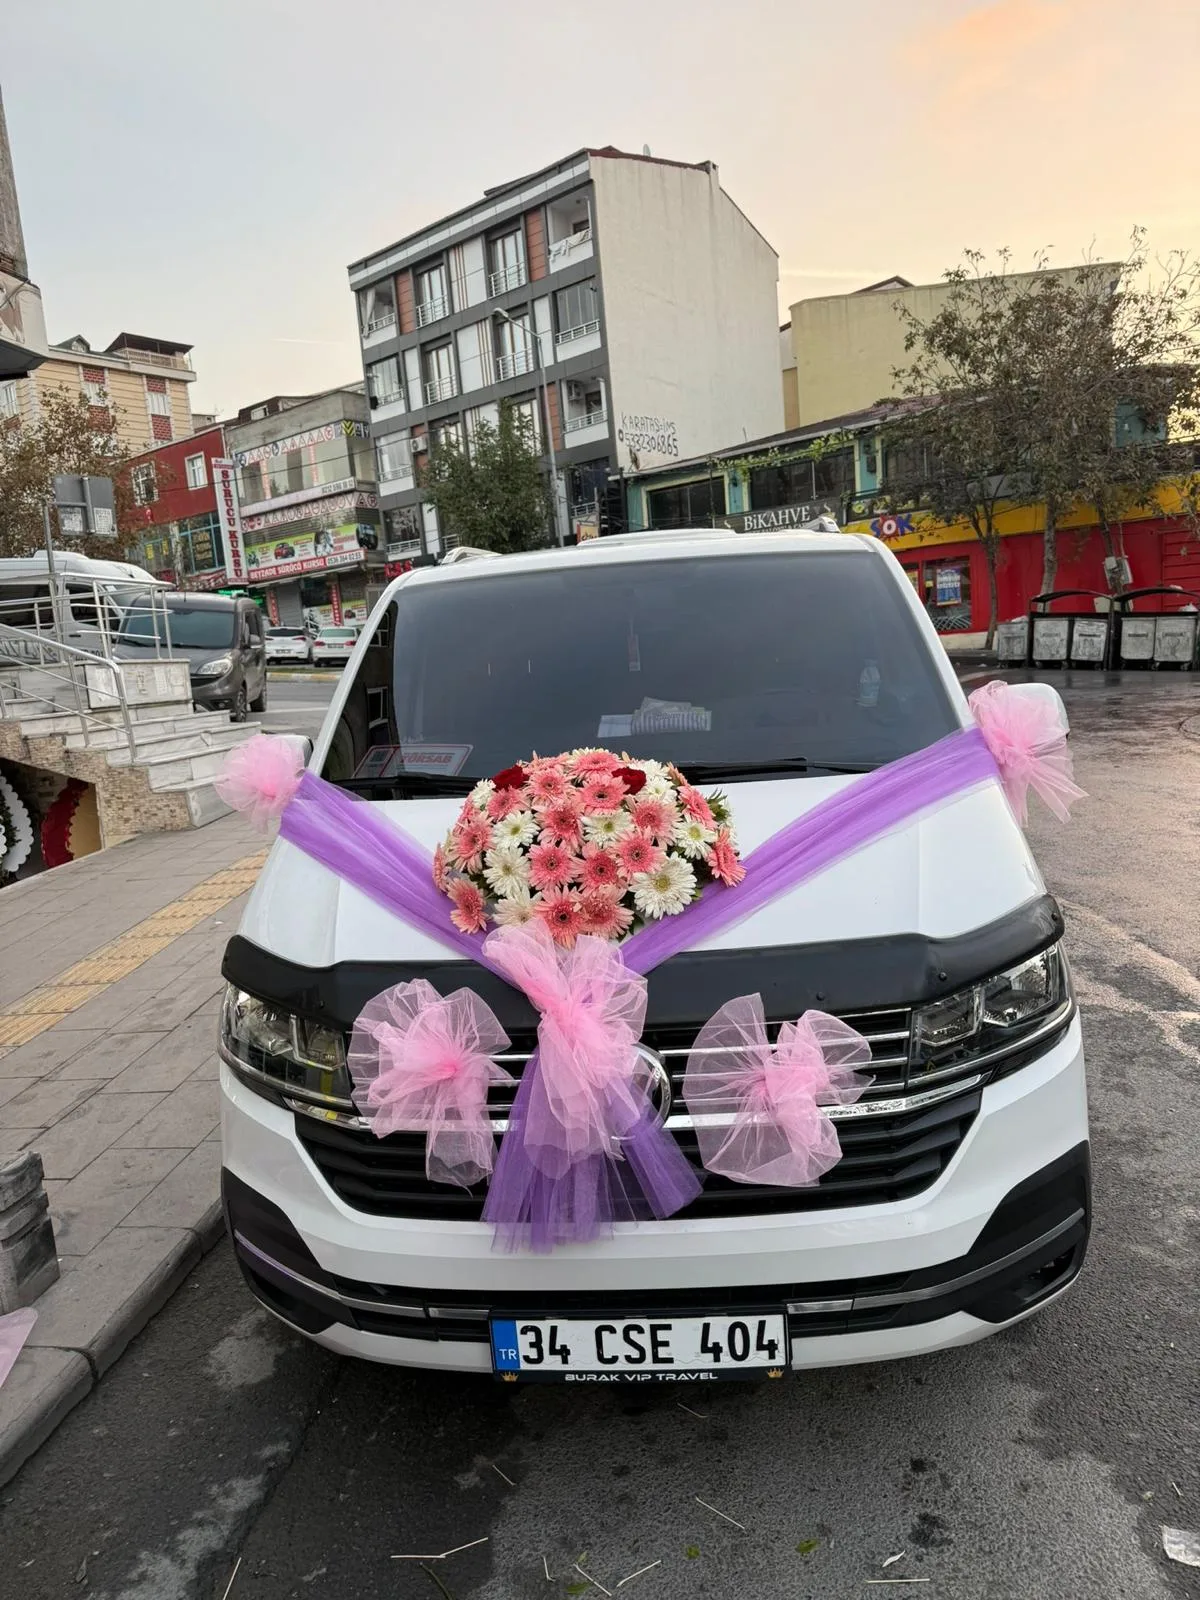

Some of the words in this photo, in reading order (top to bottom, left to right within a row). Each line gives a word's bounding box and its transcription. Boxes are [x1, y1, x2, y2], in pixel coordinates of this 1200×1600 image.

[744, 506, 810, 531] BiKAHVE
[228, 530, 243, 577] KURSU
[499, 1348, 517, 1361] TR
[520, 1324, 571, 1365] 34
[594, 1323, 675, 1365] CSE
[700, 1319, 779, 1363] 404
[565, 1373, 620, 1382] BURAK
[624, 1373, 652, 1382] VIP
[655, 1371, 718, 1382] TRAVEL
